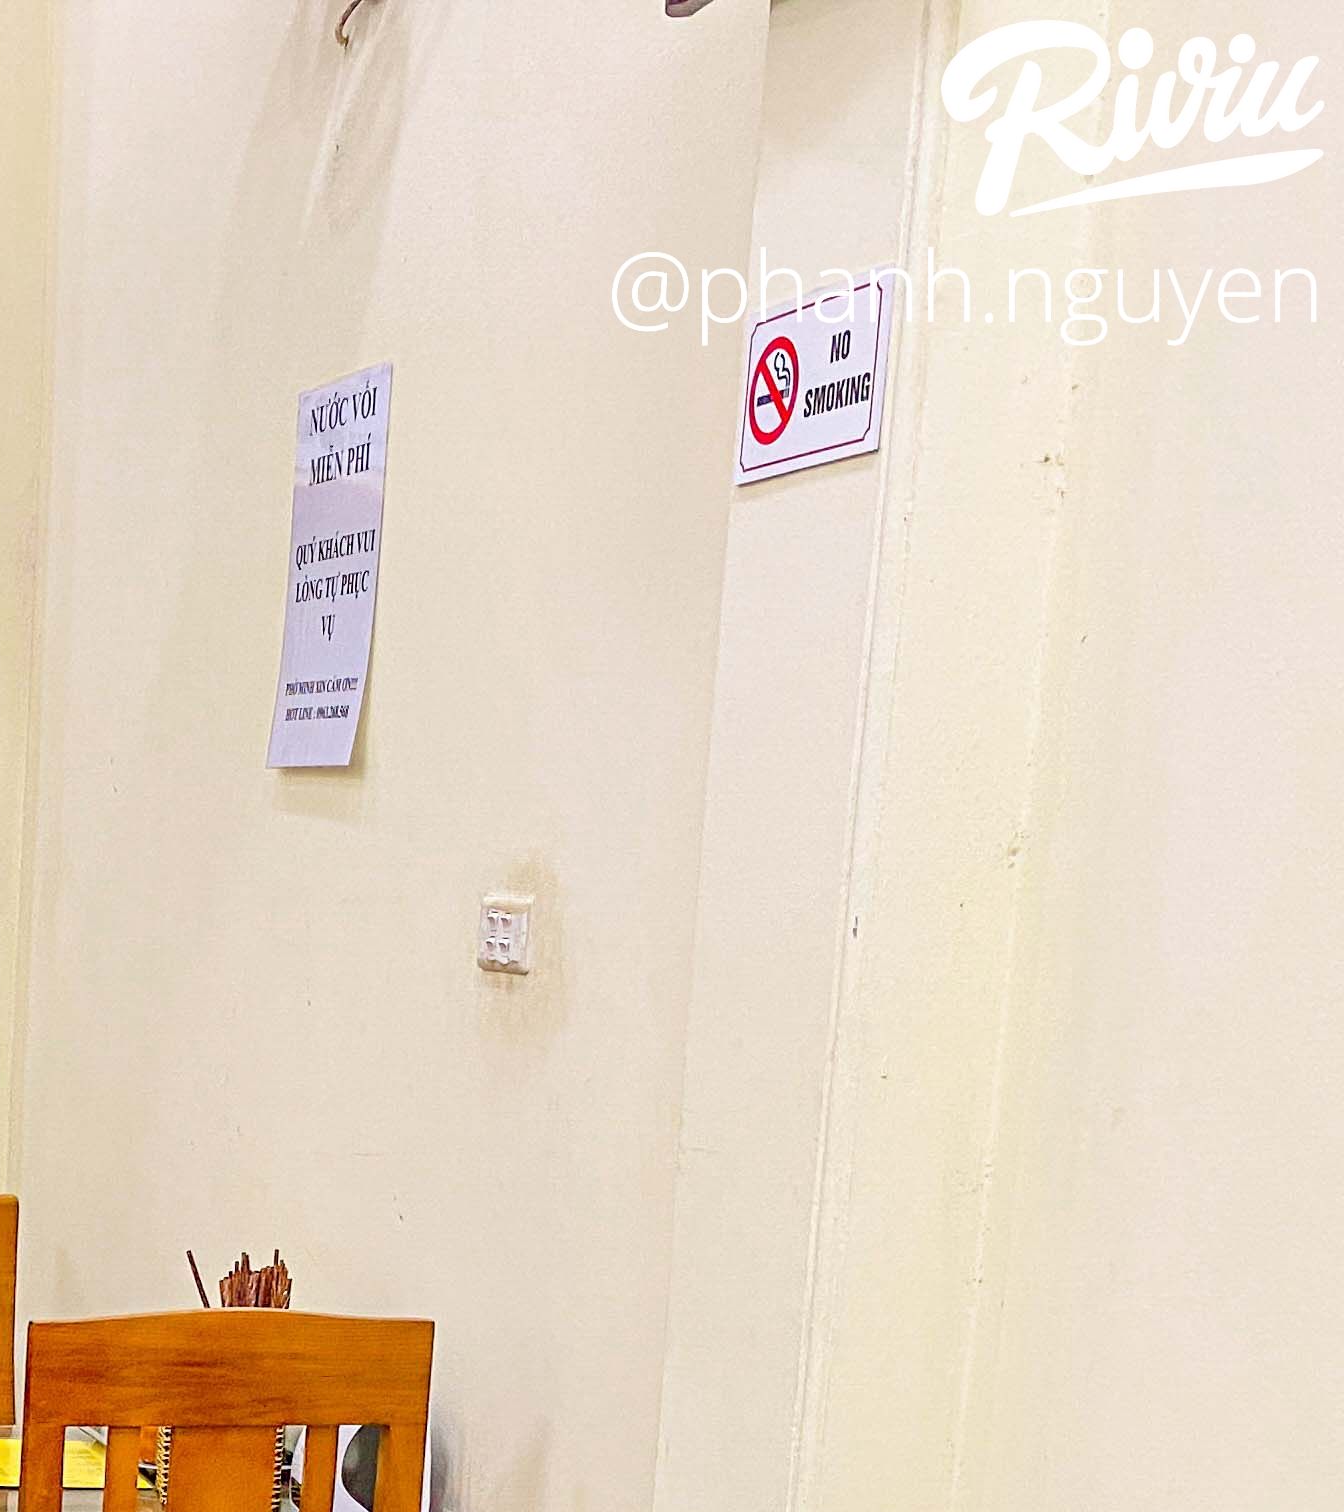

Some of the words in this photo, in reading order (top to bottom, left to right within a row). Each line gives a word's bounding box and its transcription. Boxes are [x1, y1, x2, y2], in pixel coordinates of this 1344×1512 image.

[830, 330, 851, 363] NO
[309, 391, 349, 436] NƯỚC
[803, 372, 871, 418] SMOKING
[309, 444, 344, 486] MIỄN
[346, 432, 372, 476] PHÍ
[296, 535, 317, 570] QUÝ
[318, 530, 354, 562] KHÁCH
[357, 529, 376, 554] VUI
[295, 574, 324, 603] LÒNG
[340, 570, 370, 599] PHỤC
[321, 614, 335, 642] VỤ
